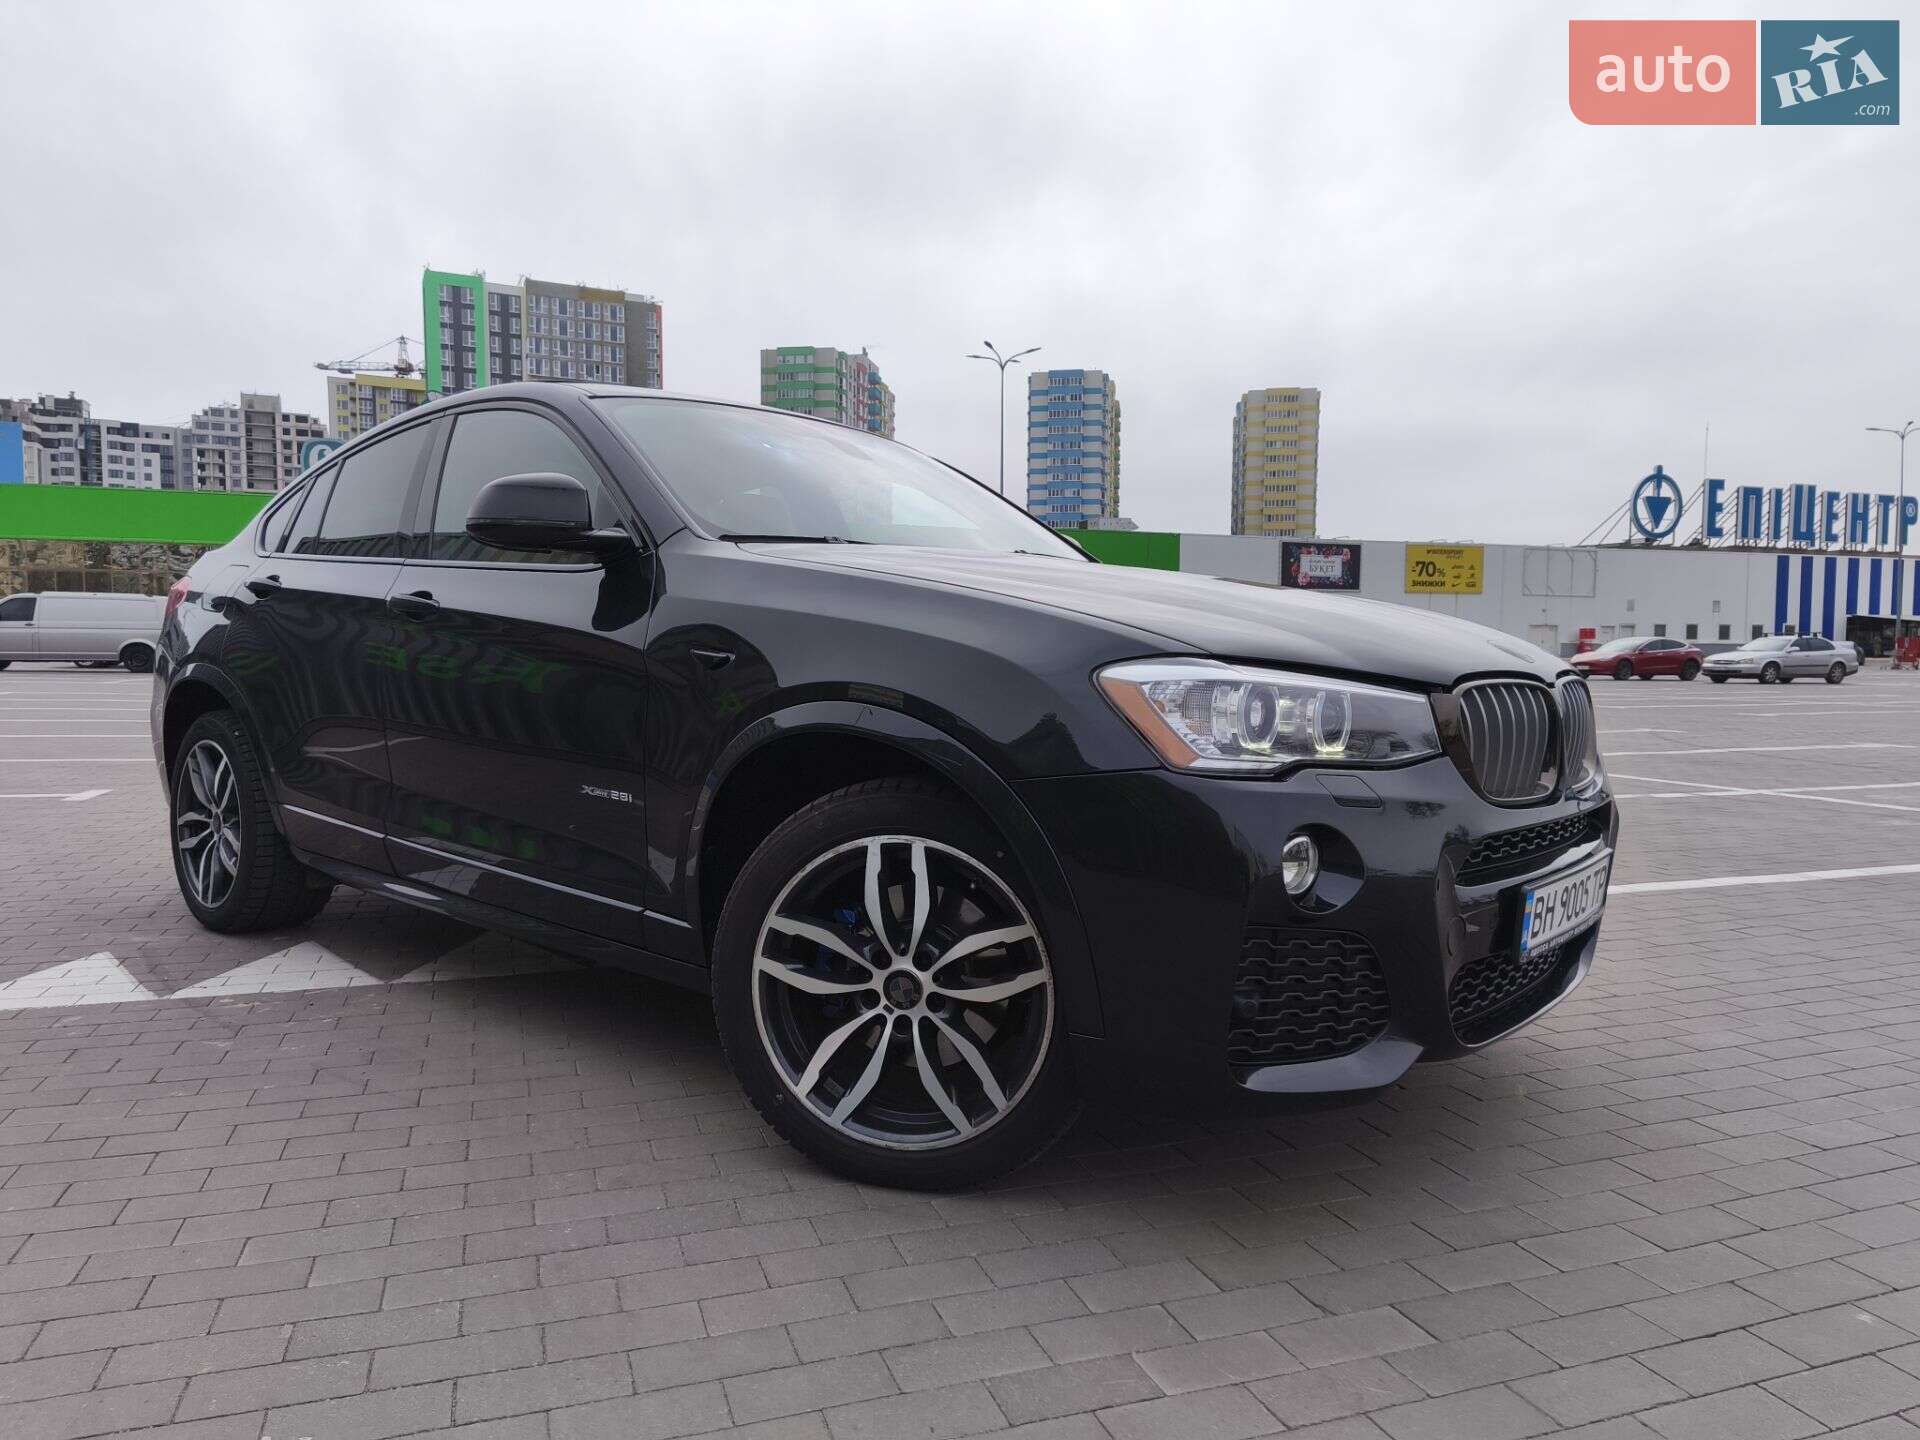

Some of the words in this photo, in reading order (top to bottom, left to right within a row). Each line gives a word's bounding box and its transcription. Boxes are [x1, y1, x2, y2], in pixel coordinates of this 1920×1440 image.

[1702, 478, 1919, 546] ЕПІЦЕНТР
[1411, 560, 1447, 577] -70%
[1530, 890, 1558, 940] BH
[1557, 874, 1592, 928] 9005
